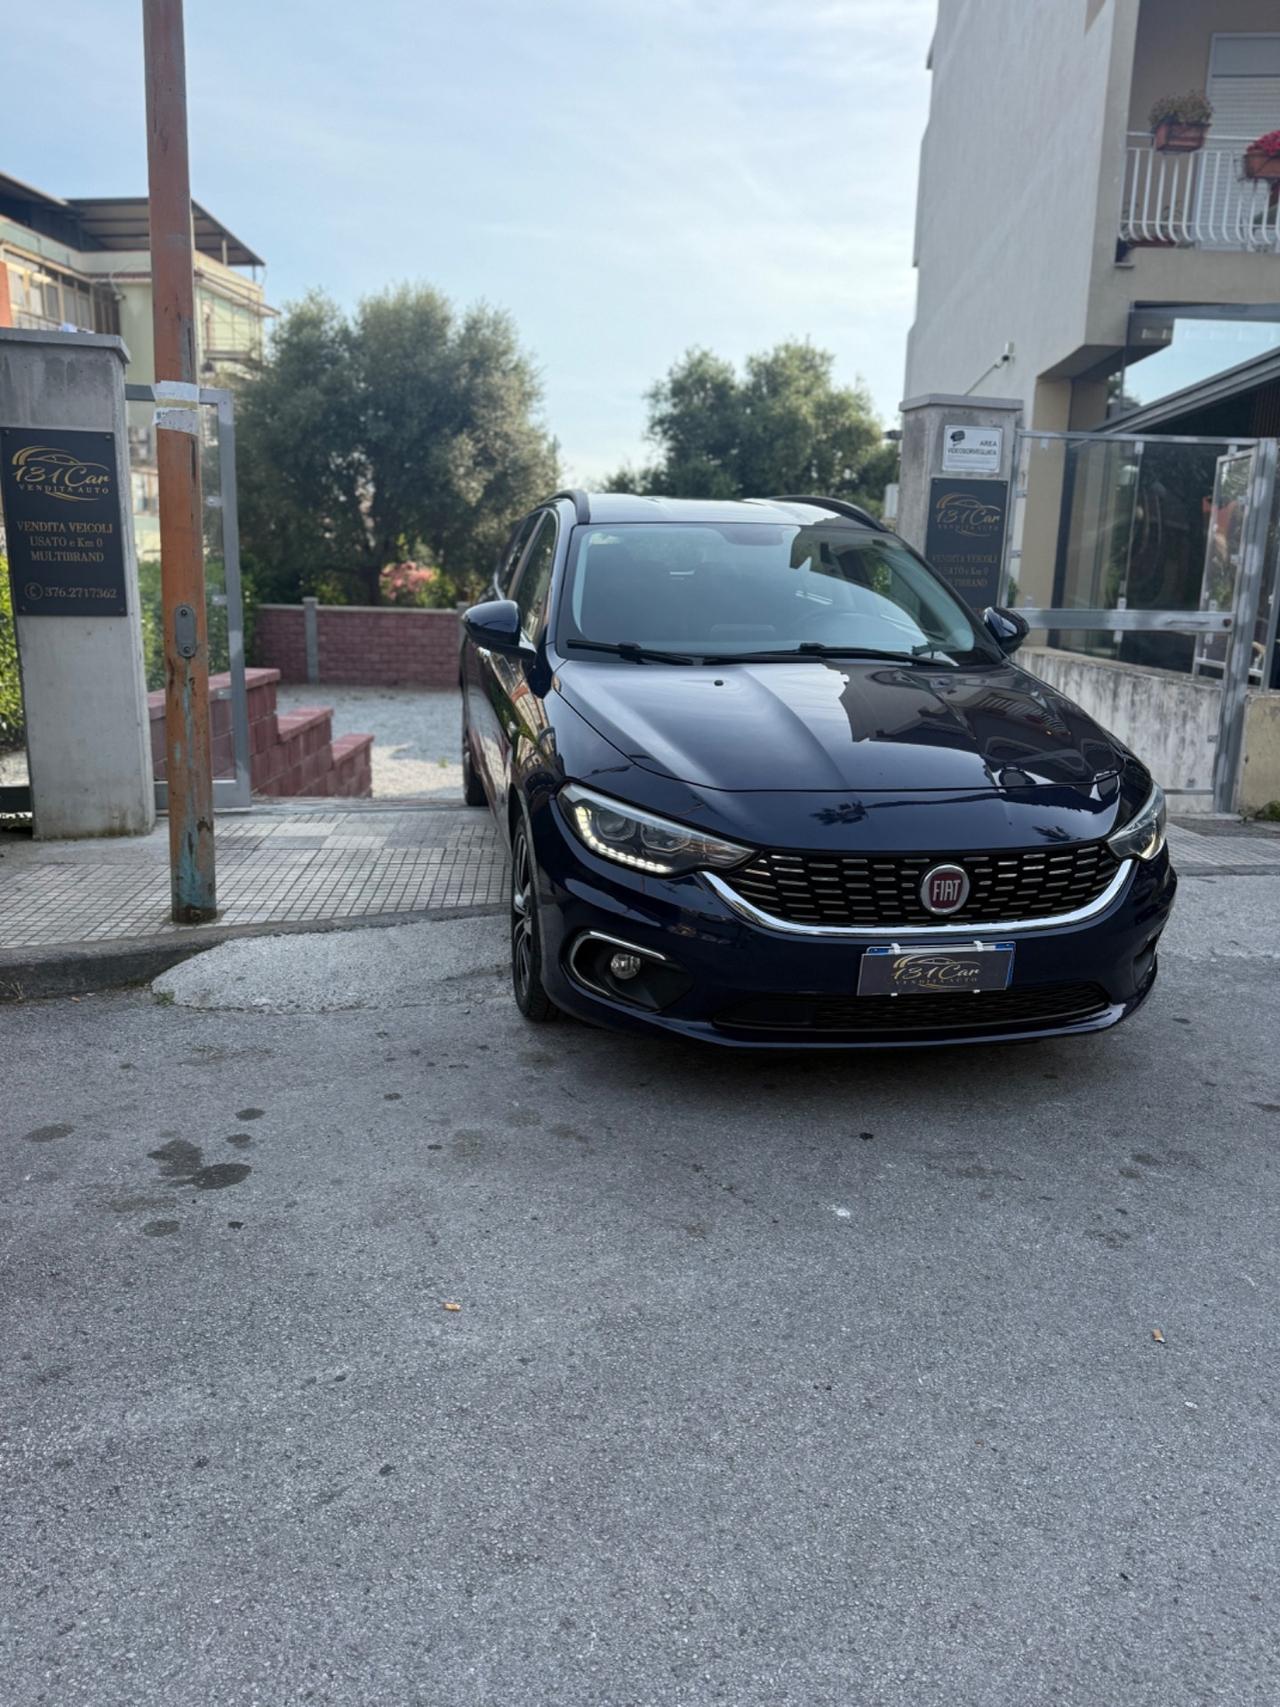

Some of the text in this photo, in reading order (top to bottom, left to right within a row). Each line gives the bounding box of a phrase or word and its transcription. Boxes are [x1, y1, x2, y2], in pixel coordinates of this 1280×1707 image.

[65, 466, 111, 488] Car
[19, 483, 109, 495] VENDITA AUTO
[969, 508, 1000, 526] Car
[17, 521, 112, 534] VENDITA VEICOLI
[30, 536, 67, 548] USATO
[69, 539, 76, 547] e
[77, 537, 94, 548] Km
[31, 550, 104, 562] MULTIBRAND
[932, 879, 961, 901] FIAT
[938, 964, 980, 980] Car
